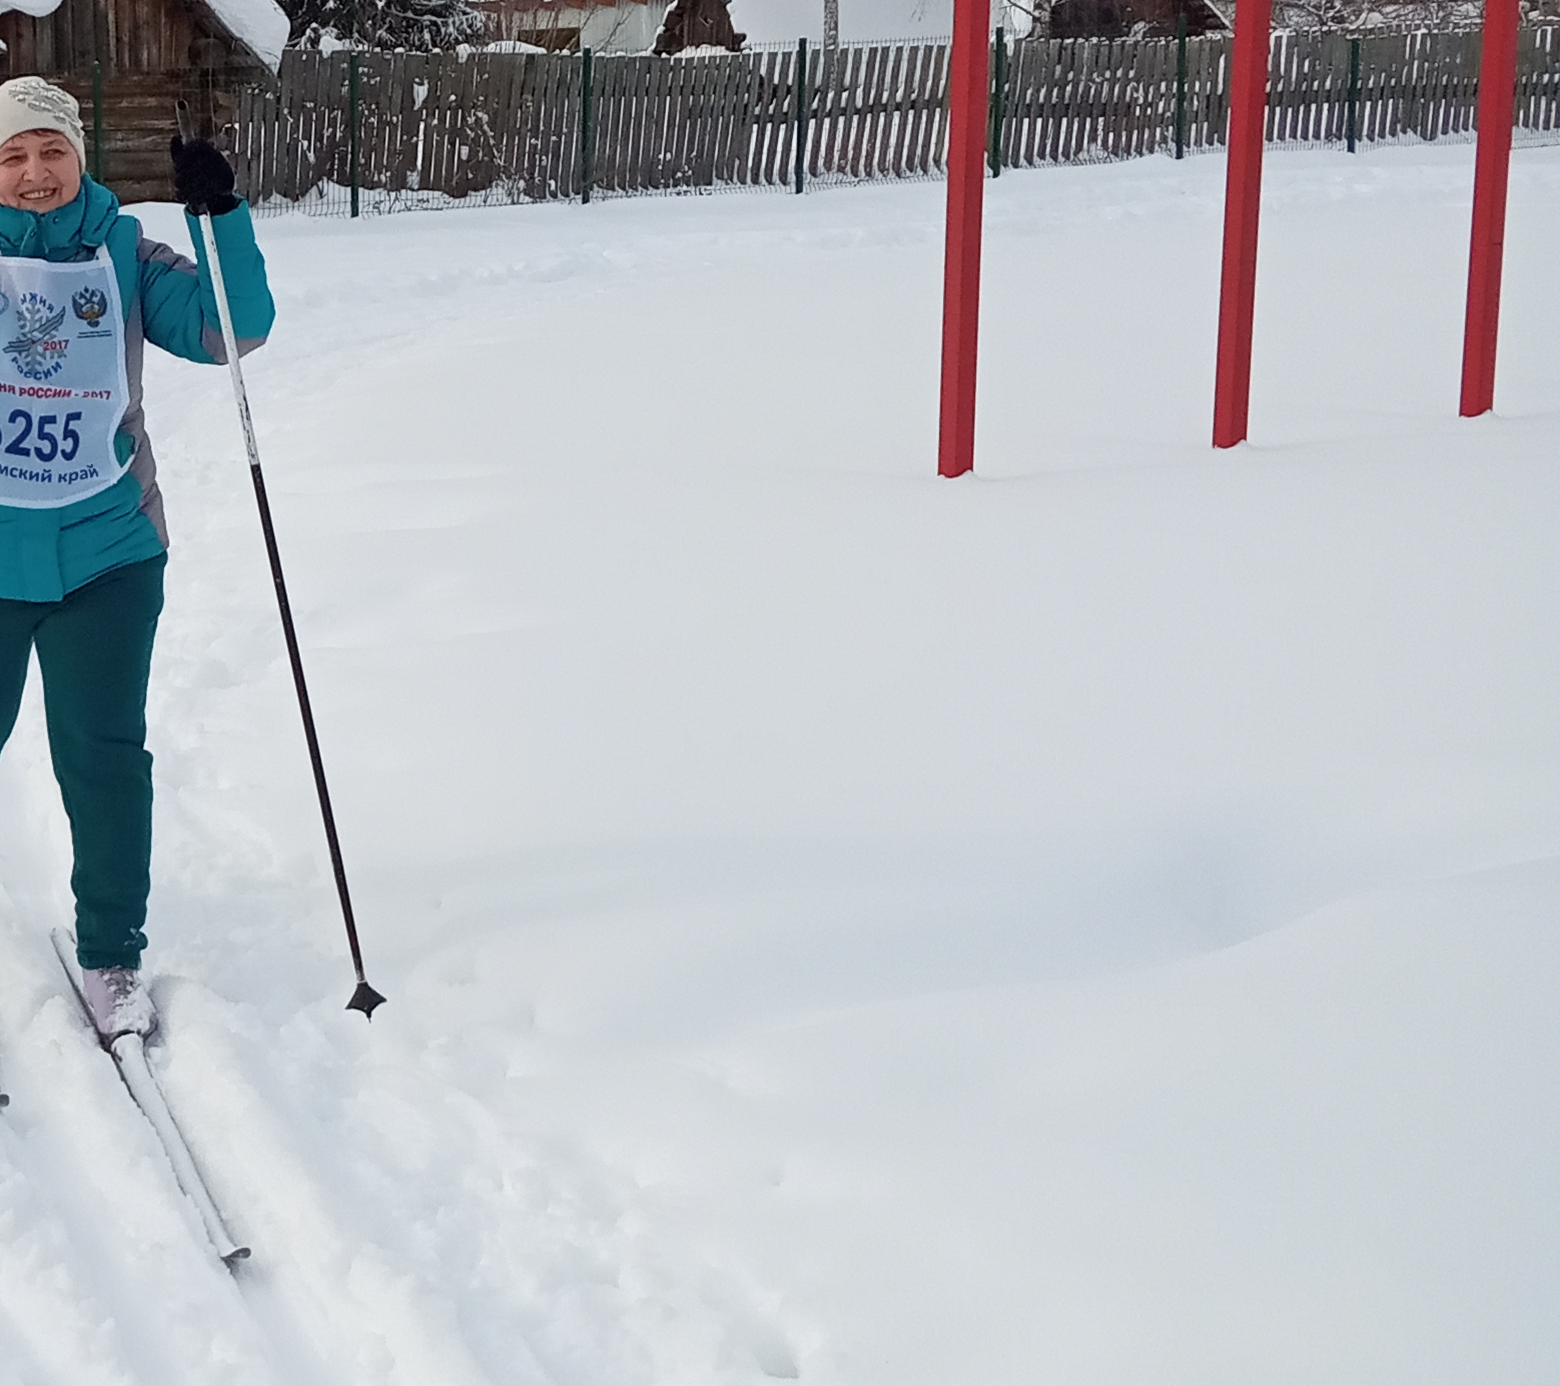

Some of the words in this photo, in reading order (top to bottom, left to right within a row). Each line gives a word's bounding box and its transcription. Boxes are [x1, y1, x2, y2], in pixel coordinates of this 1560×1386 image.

[43, 339, 70, 351] 2017
[11, 356, 62, 381] РОССИИ
[18, 386, 72, 399] РОССИИ
[57, 464, 100, 485] край
